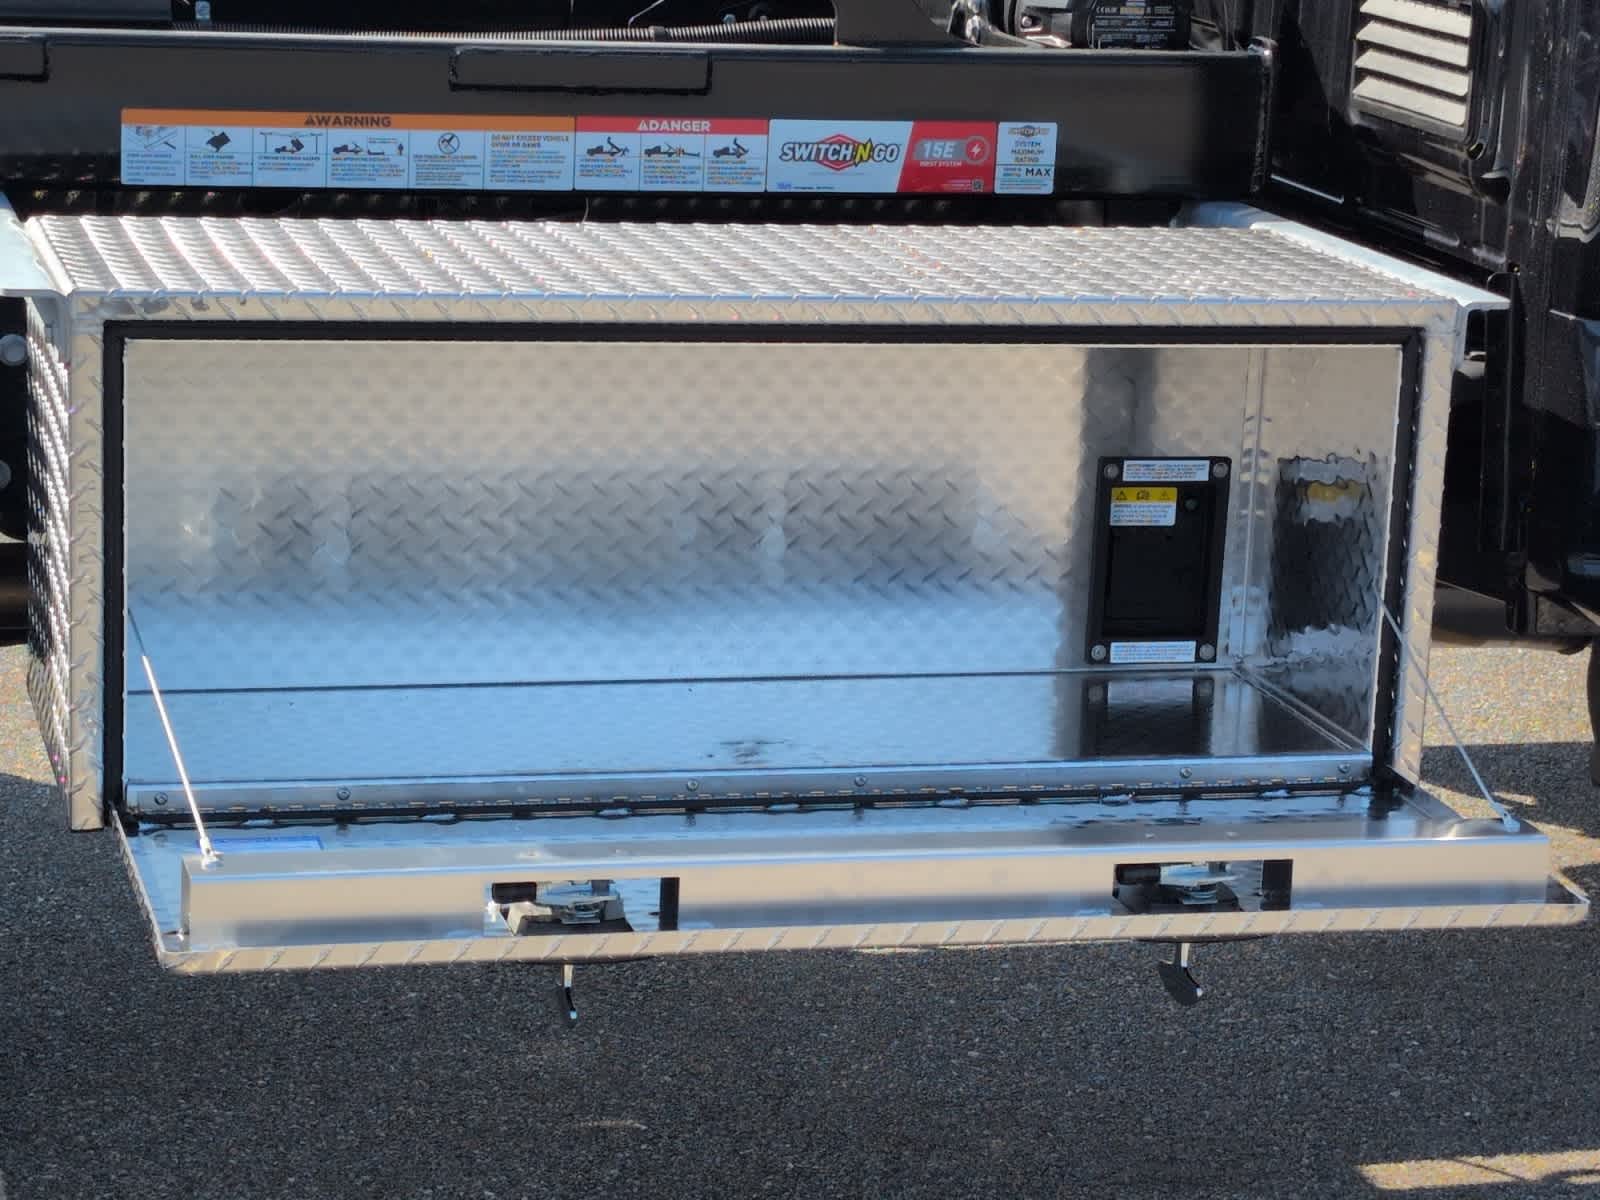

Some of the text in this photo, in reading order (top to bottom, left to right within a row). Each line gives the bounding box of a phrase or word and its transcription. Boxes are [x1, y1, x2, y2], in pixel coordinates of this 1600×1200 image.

[314, 115, 392, 128] WARNING
[648, 120, 711, 132] DANGER
[923, 141, 955, 159] 15E
[1025, 167, 1052, 178] MAX
